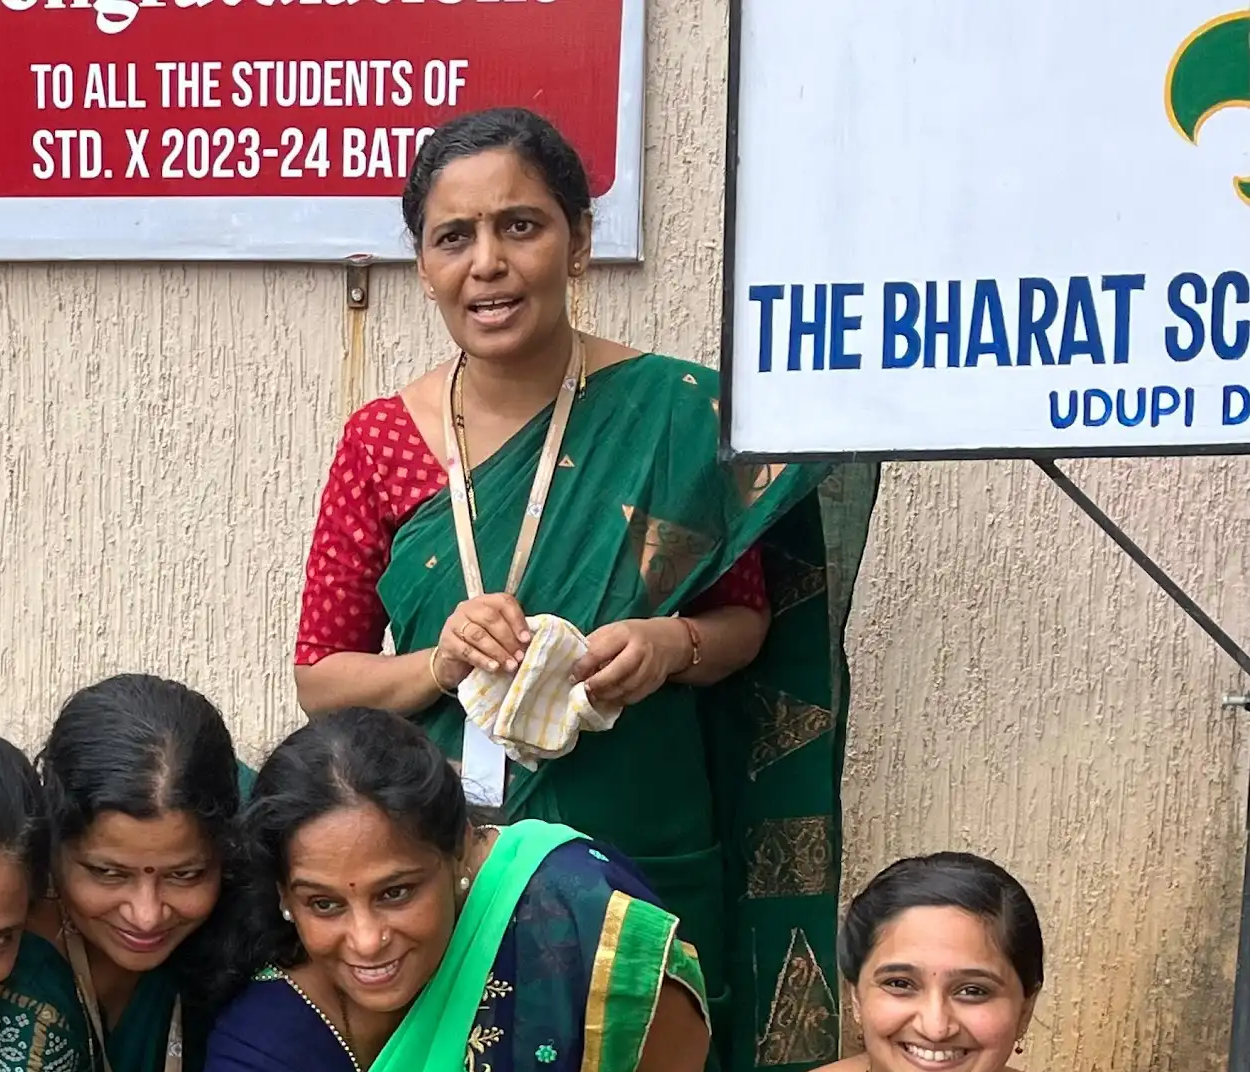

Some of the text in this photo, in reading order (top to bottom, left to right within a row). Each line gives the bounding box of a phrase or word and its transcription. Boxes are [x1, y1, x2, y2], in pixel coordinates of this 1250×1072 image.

[31, 59, 469, 110] TO ALL THE STUDENTS OF
[32, 129, 113, 180] STD.
[125, 128, 150, 179] X
[161, 127, 331, 179] 2023-24
[748, 282, 865, 373] THE
[881, 273, 1146, 370] BHARAT
[1048, 385, 1195, 430] UDUPI
